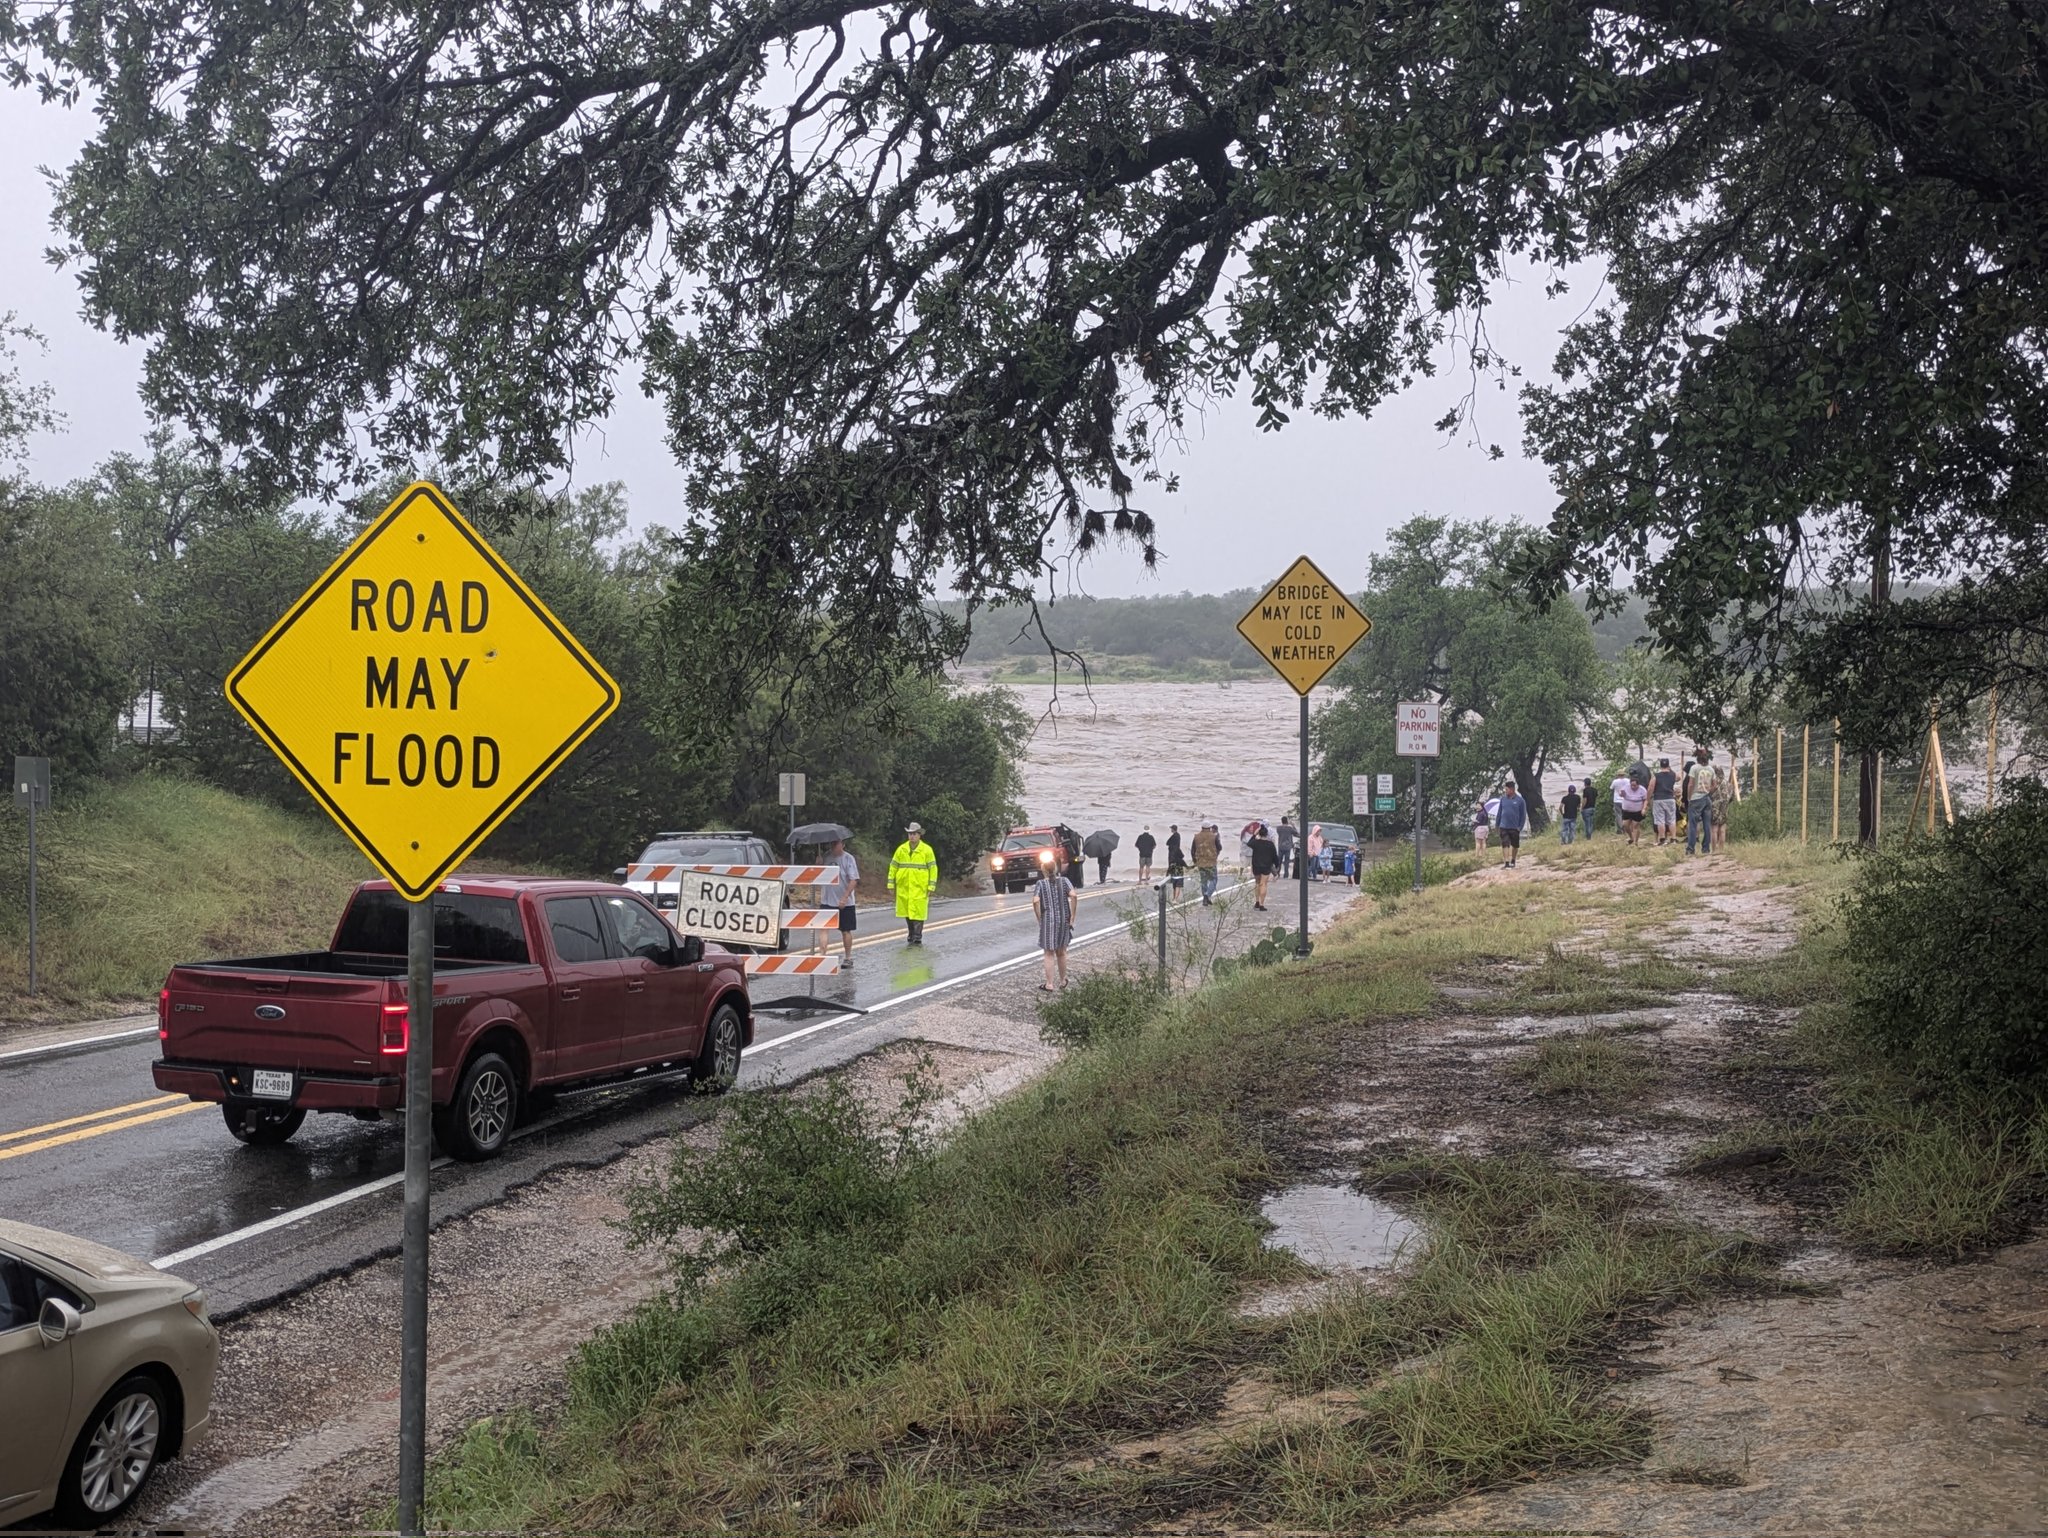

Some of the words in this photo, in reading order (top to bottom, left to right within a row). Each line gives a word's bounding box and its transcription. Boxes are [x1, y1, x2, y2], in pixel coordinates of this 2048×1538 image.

[1278, 585, 1329, 600] BRIDGE
[350, 579, 489, 634] ROAD
[1262, 606, 1291, 620] MAY
[1300, 605, 1322, 620] ICE
[1332, 605, 1345, 619] IN
[1285, 625, 1321, 640] COLD
[1272, 645, 1336, 660] WEATHER
[365, 656, 470, 710] MAY
[1411, 708, 1427, 719] NO
[1400, 721, 1437, 732] PARKING
[333, 732, 500, 789] FLOOD
[700, 881, 760, 906] ROAD
[685, 907, 770, 935] CLOSED
